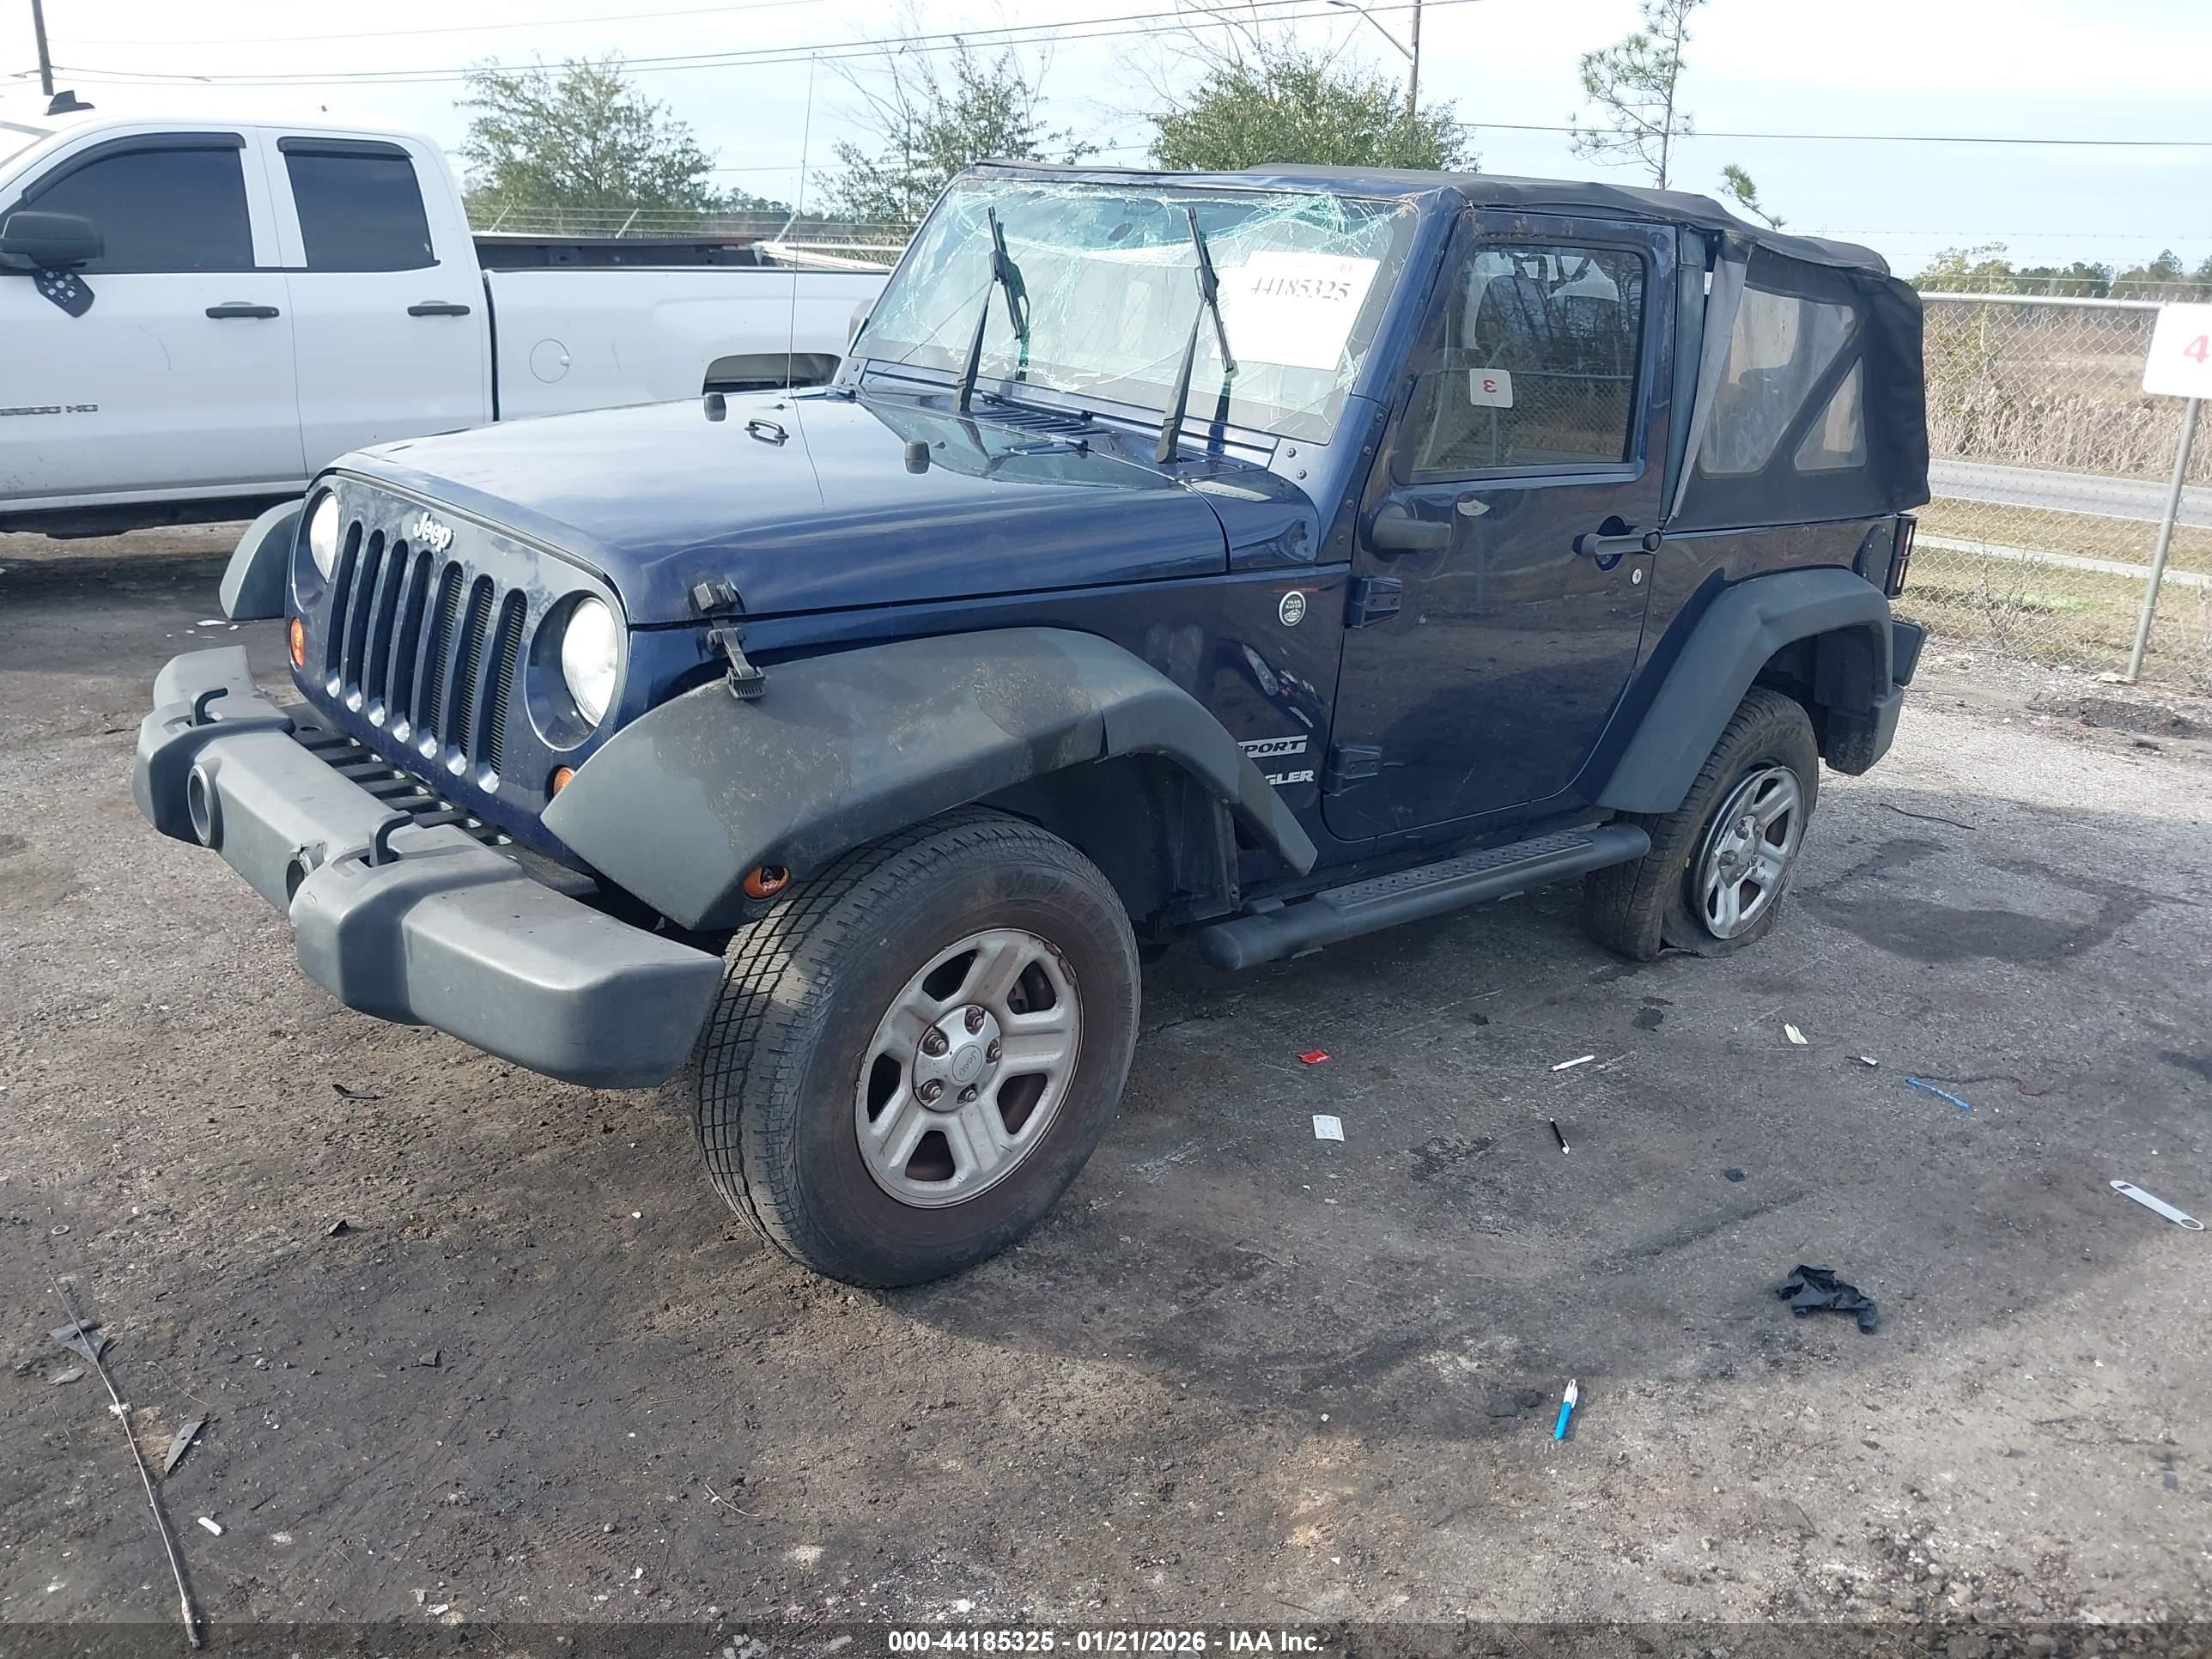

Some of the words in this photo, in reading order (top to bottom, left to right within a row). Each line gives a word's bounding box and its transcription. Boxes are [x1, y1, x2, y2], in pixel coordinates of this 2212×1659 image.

[1251, 276, 1351, 301] 44185325
[2184, 335, 2210, 363] 4
[65, 404, 98, 413] HD
[413, 511, 452, 553] Jeep
[1241, 739, 1306, 753] PORT
[1265, 769, 1314, 785] GLER
